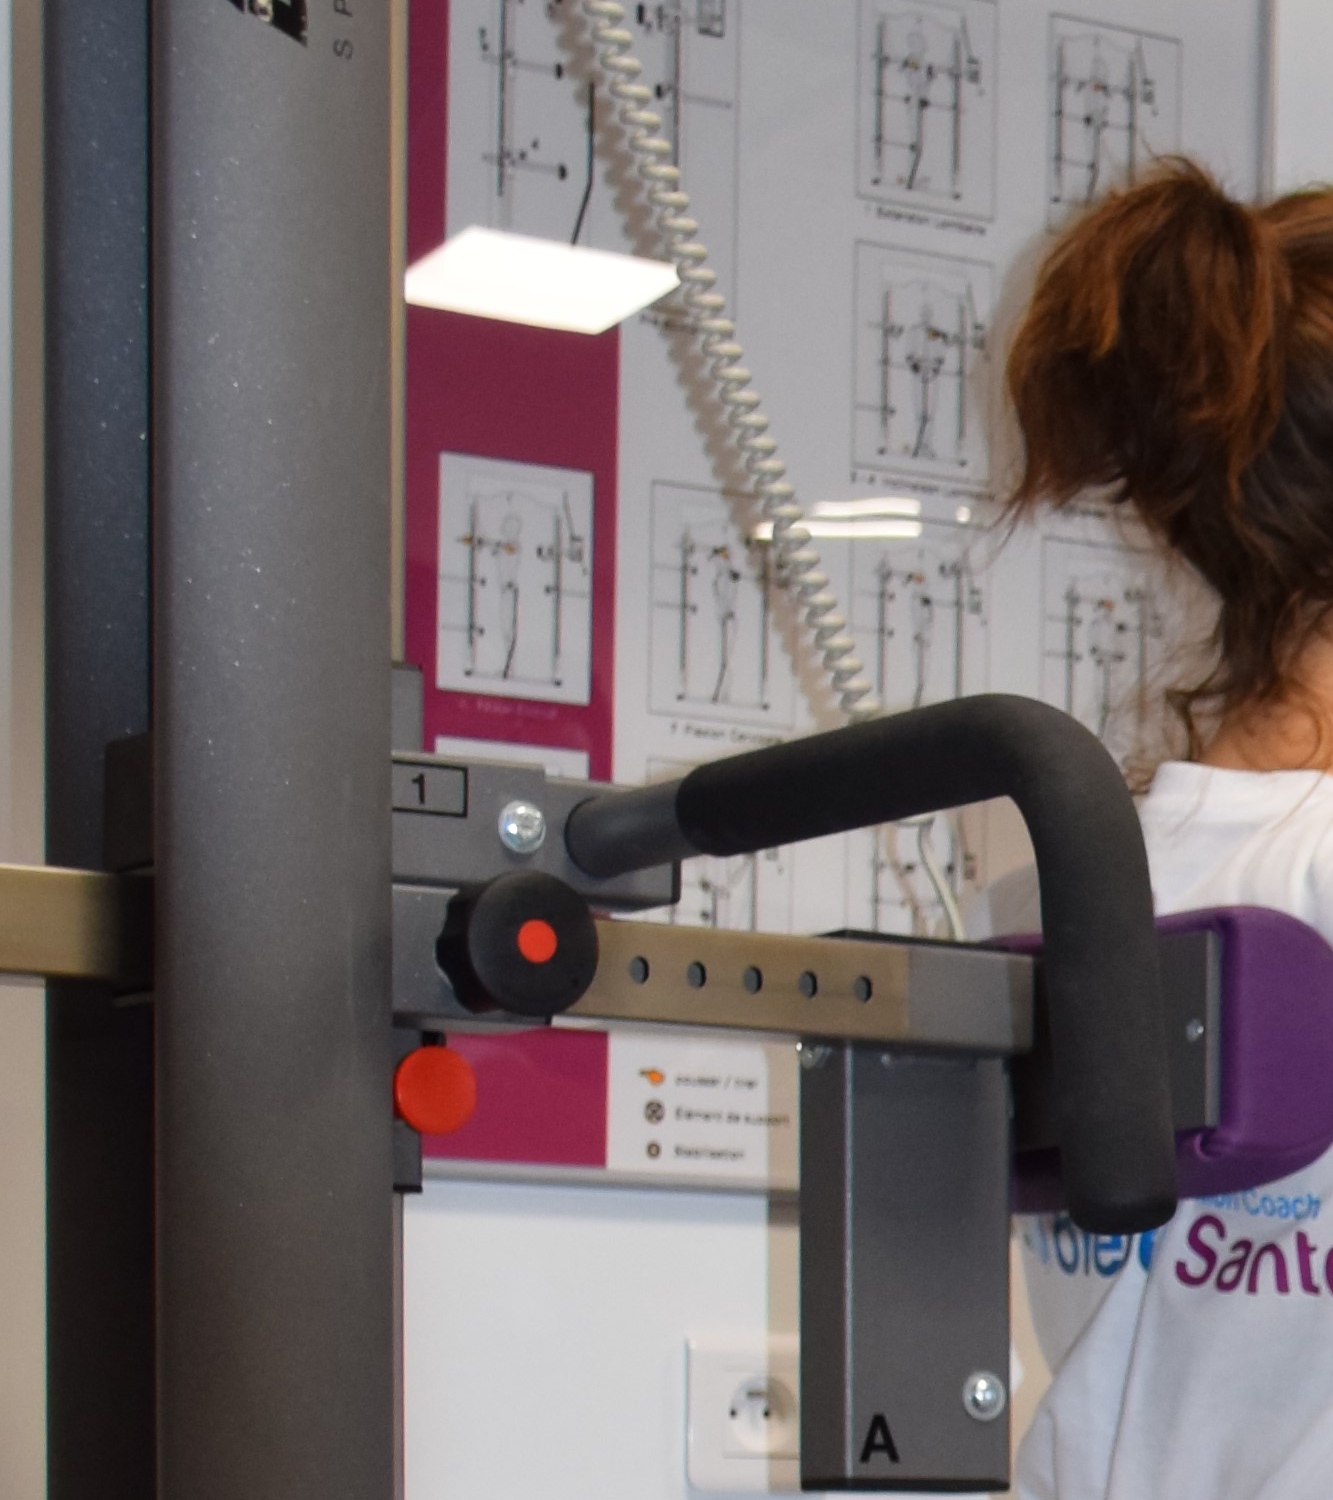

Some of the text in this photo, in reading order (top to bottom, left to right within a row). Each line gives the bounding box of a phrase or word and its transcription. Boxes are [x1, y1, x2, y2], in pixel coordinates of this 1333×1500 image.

[411, 773, 427, 805] 1
[1243, 1190, 1322, 1221] Coach
[859, 1412, 900, 1465] A
